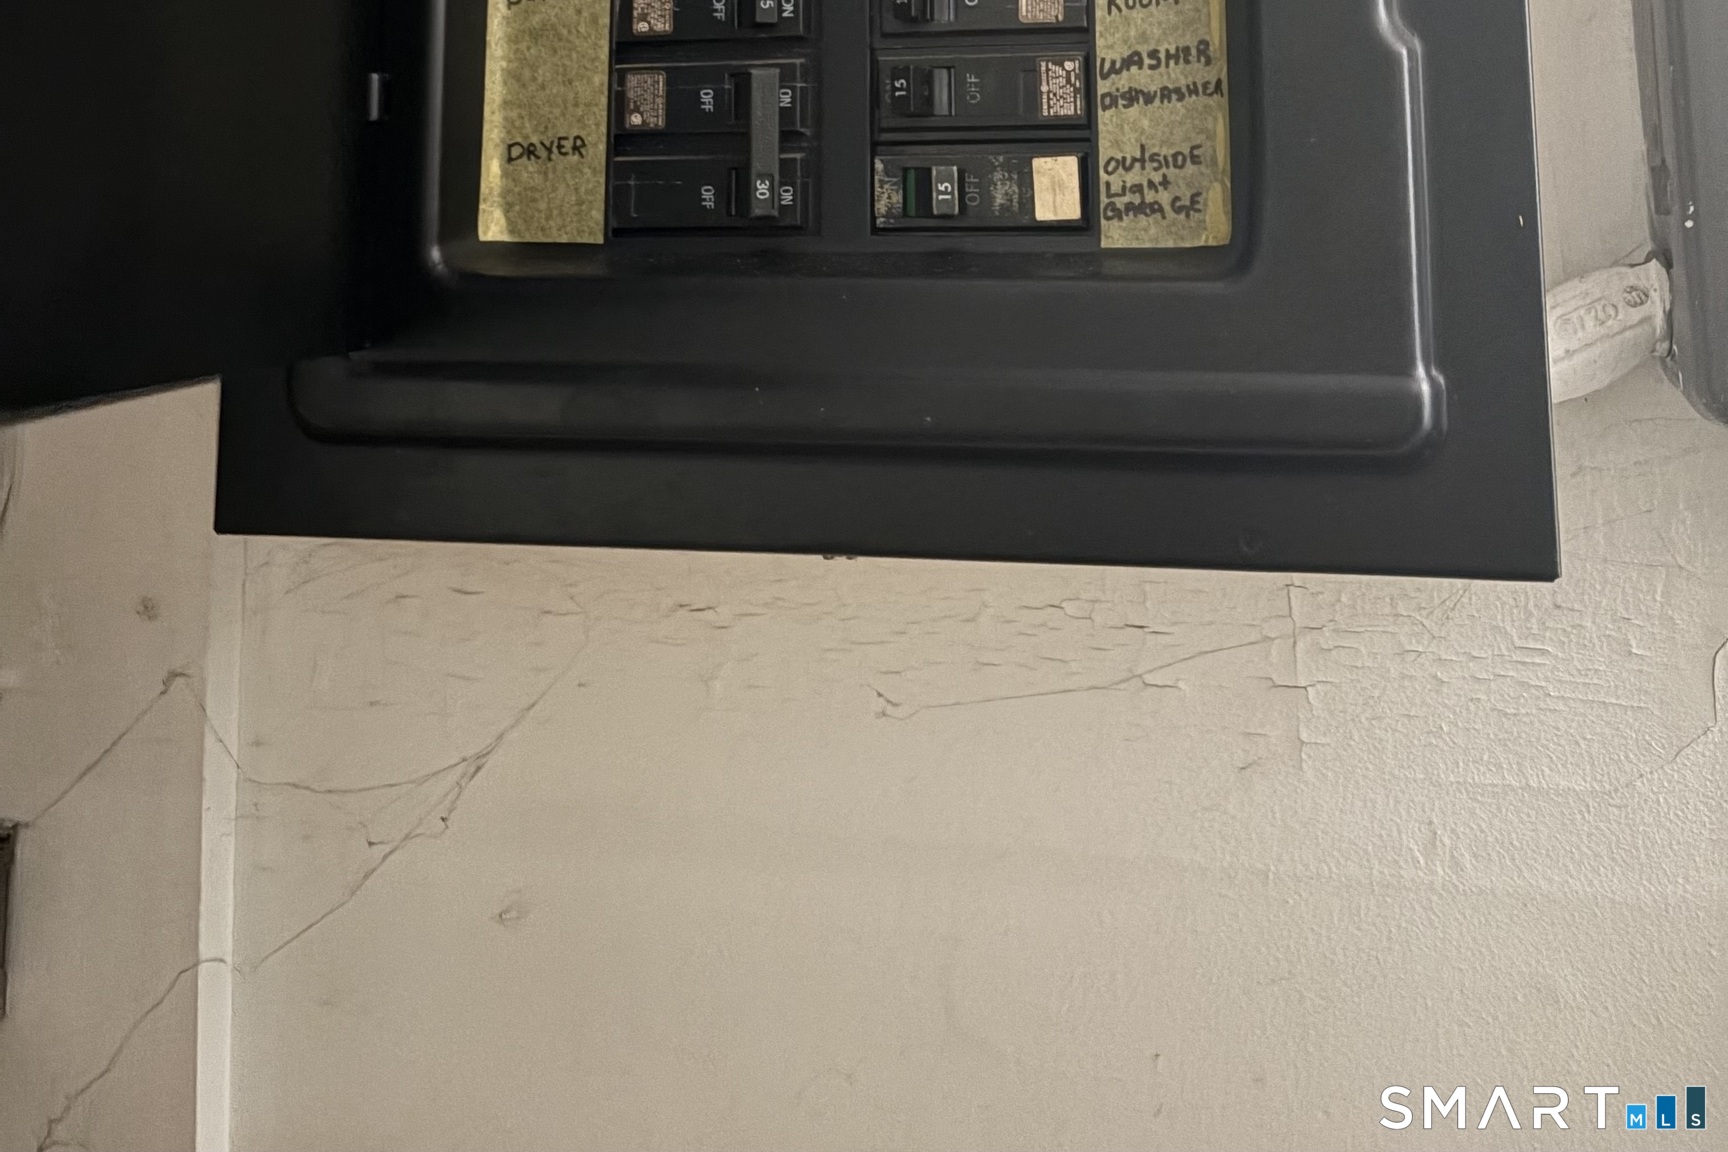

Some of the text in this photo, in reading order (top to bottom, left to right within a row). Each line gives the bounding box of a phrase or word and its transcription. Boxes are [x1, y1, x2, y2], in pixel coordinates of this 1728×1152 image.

[1098, 39, 1212, 80] WASHER
[779, 88, 792, 108] ON
[894, 78, 907, 97] 15
[966, 73, 981, 103] OFF
[700, 89, 714, 113] OFF
[507, 134, 587, 164] DRYER
[701, 186, 715, 209] OFF
[756, 180, 769, 199] 30
[780, 186, 793, 205] ON
[938, 182, 951, 201] 15
[965, 173, 980, 206] OFF
